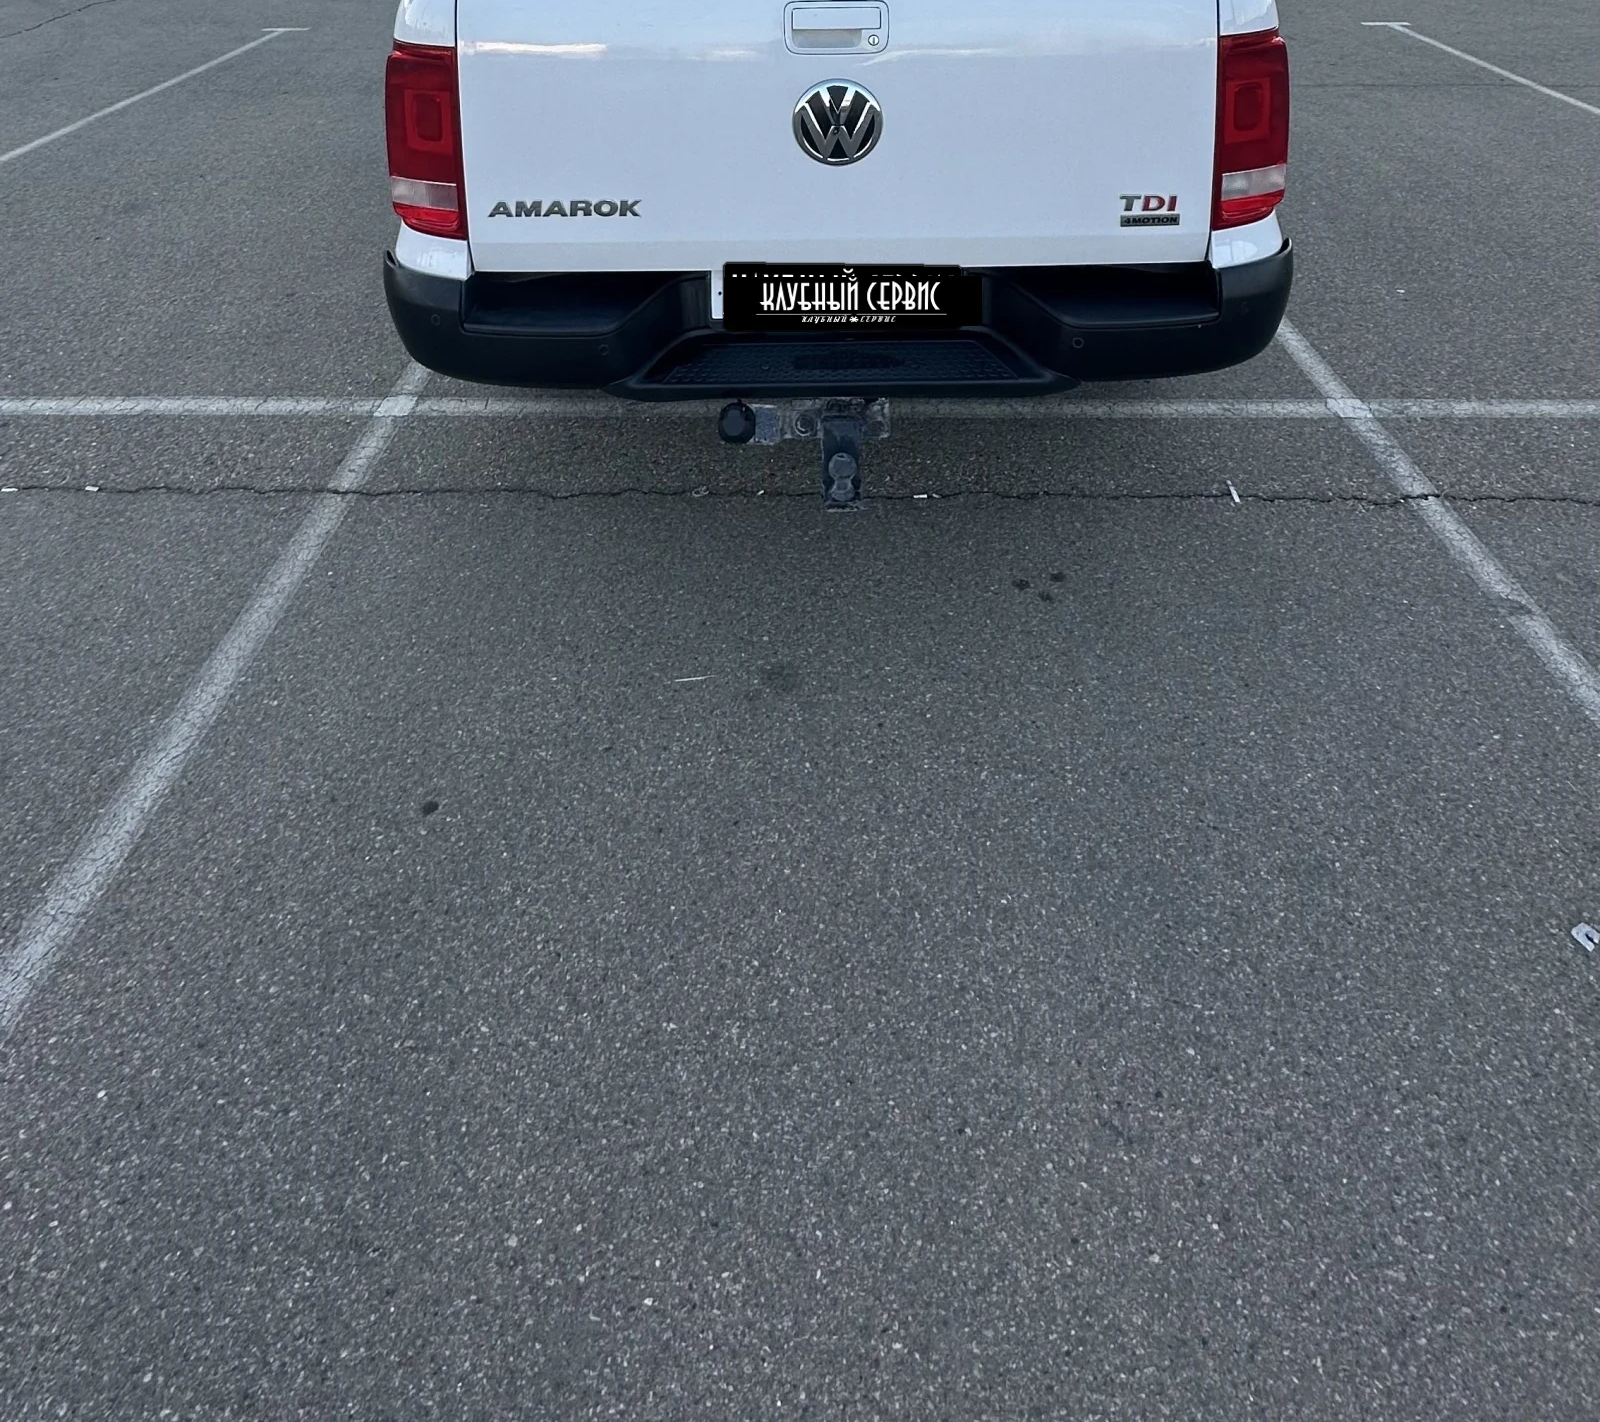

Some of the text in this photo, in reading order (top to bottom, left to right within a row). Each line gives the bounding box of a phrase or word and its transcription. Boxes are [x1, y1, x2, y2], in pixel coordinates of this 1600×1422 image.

[488, 199, 643, 218] AMAROK
[1119, 193, 1178, 212] TDI
[1123, 216, 1178, 224] 4MOTION
